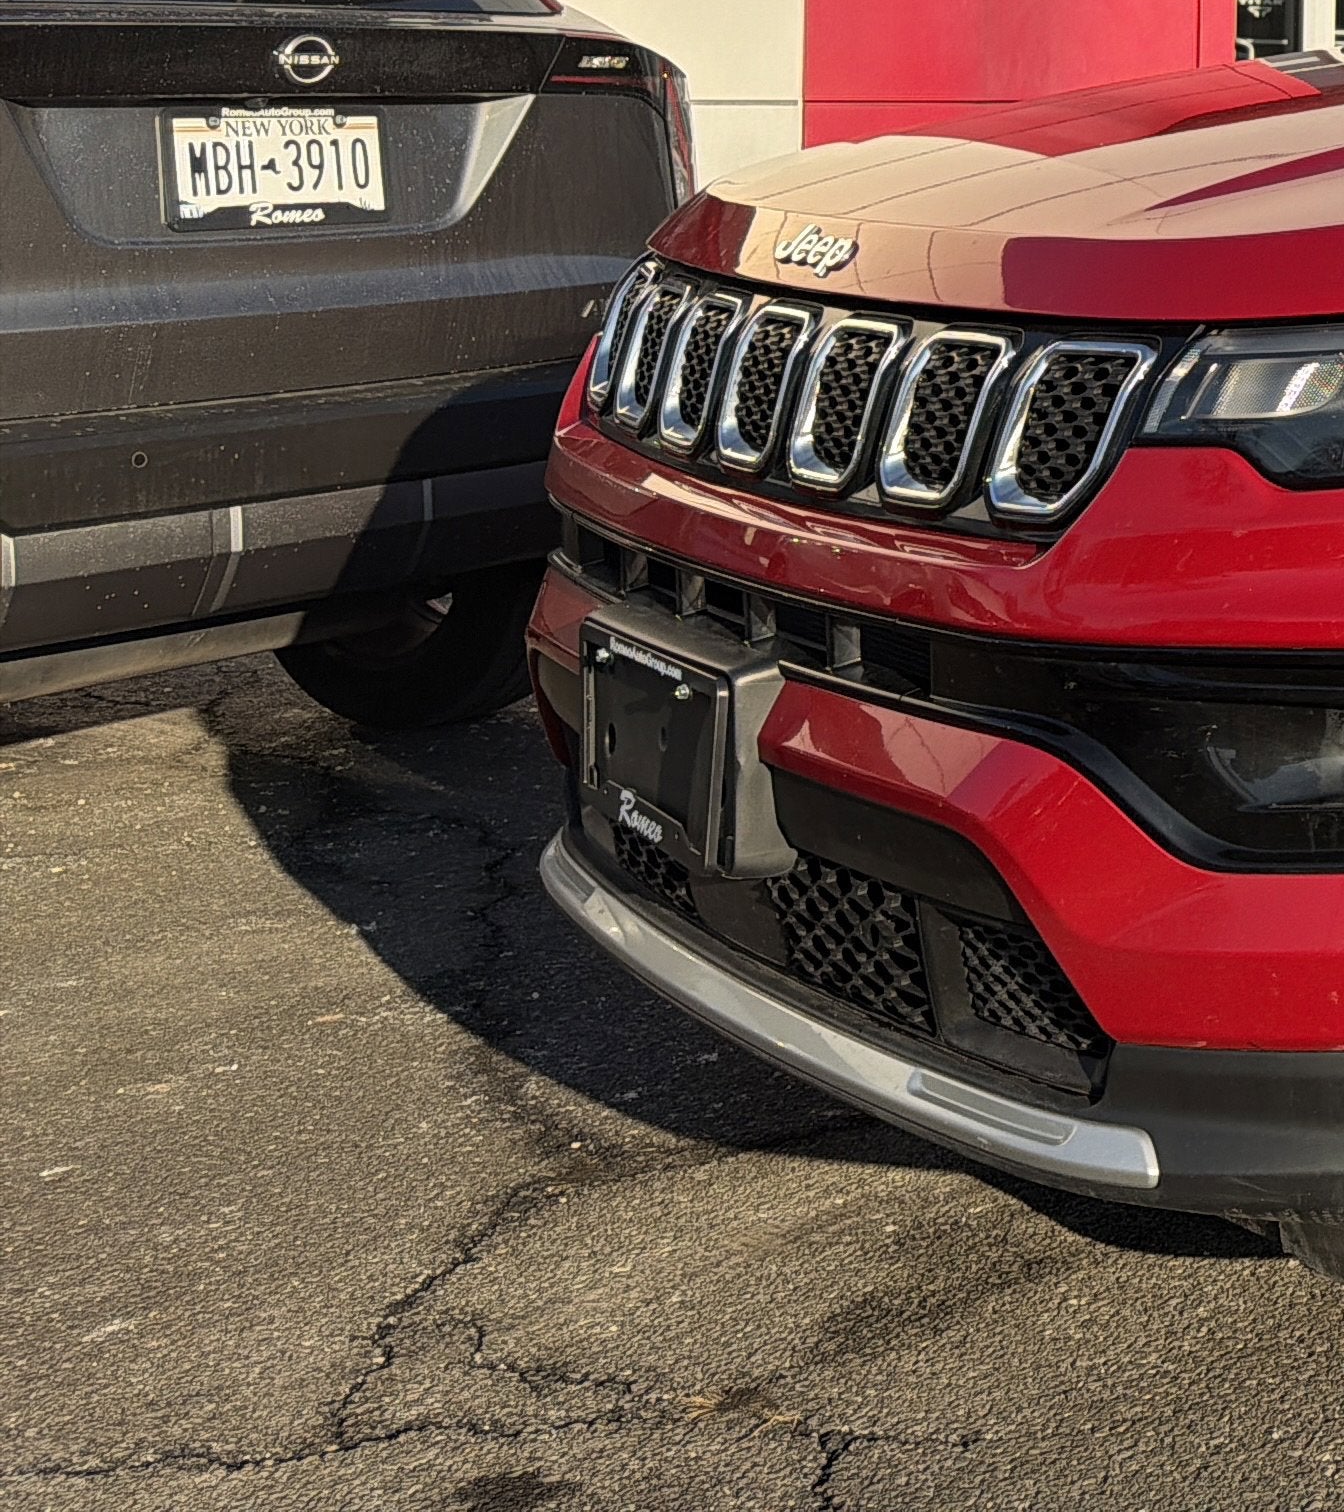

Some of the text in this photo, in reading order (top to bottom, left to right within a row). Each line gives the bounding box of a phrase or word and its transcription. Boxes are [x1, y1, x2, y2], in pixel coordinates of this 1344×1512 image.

[279, 54, 340, 66] NISSAN
[225, 118, 331, 137] NEW YORK
[188, 138, 371, 198] MBH 3910
[249, 202, 326, 226] Romeo
[775, 223, 855, 278] Jeep
[618, 789, 663, 844] Romeo
